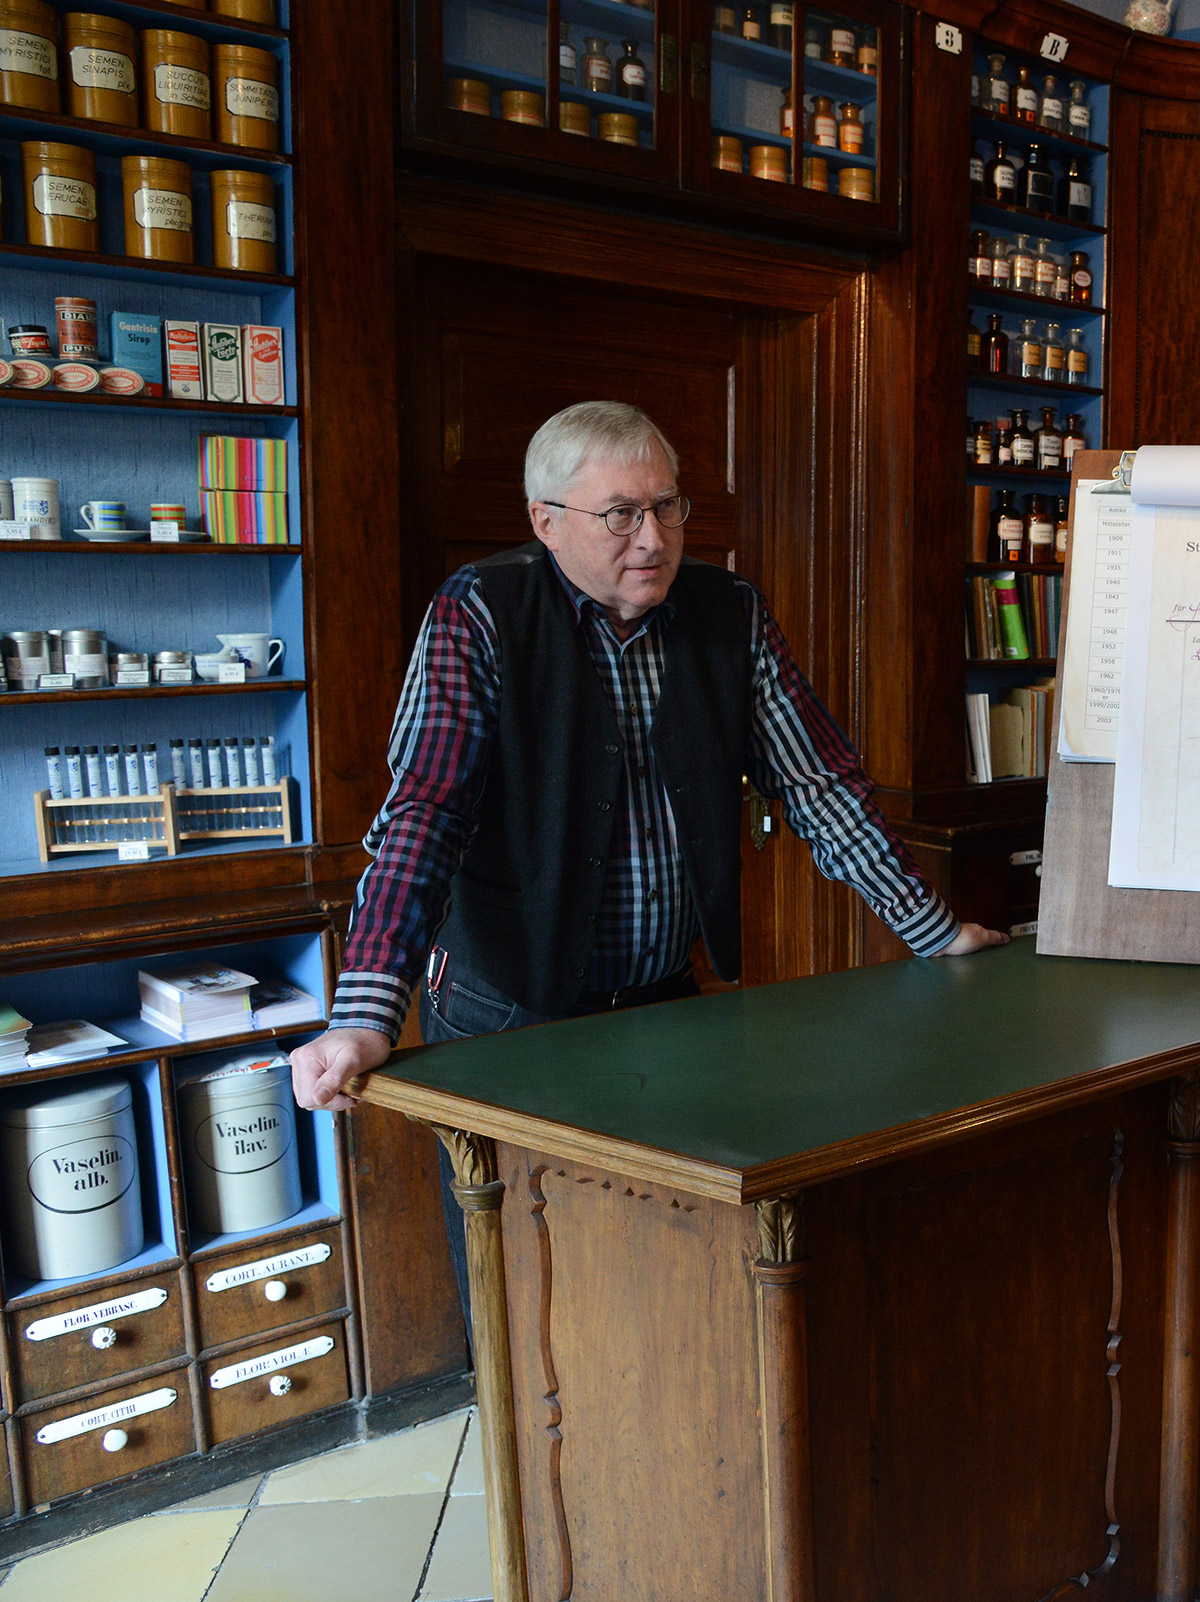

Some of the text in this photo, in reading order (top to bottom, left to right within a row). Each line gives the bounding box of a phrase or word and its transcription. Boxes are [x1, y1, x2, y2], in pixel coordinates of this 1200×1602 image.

[9, 36, 48, 51] SEMEN
[945, 30, 954, 48] 3
[1050, 39, 1061, 57] B
[88, 55, 125, 68] SEMEN
[82, 65, 125, 79] SINAPIS
[166, 71, 204, 85] SUCCUS
[148, 195, 183, 206] SEMEN
[119, 321, 158, 334] Gantrisin
[128, 333, 151, 348] Sirup
[1172, 603, 1186, 613] für
[215, 1116, 280, 1139] Vaselin.
[51, 1148, 123, 1175] Vaselin.
[73, 1171, 109, 1191] alb.
[225, 1267, 260, 1284] CORT.
